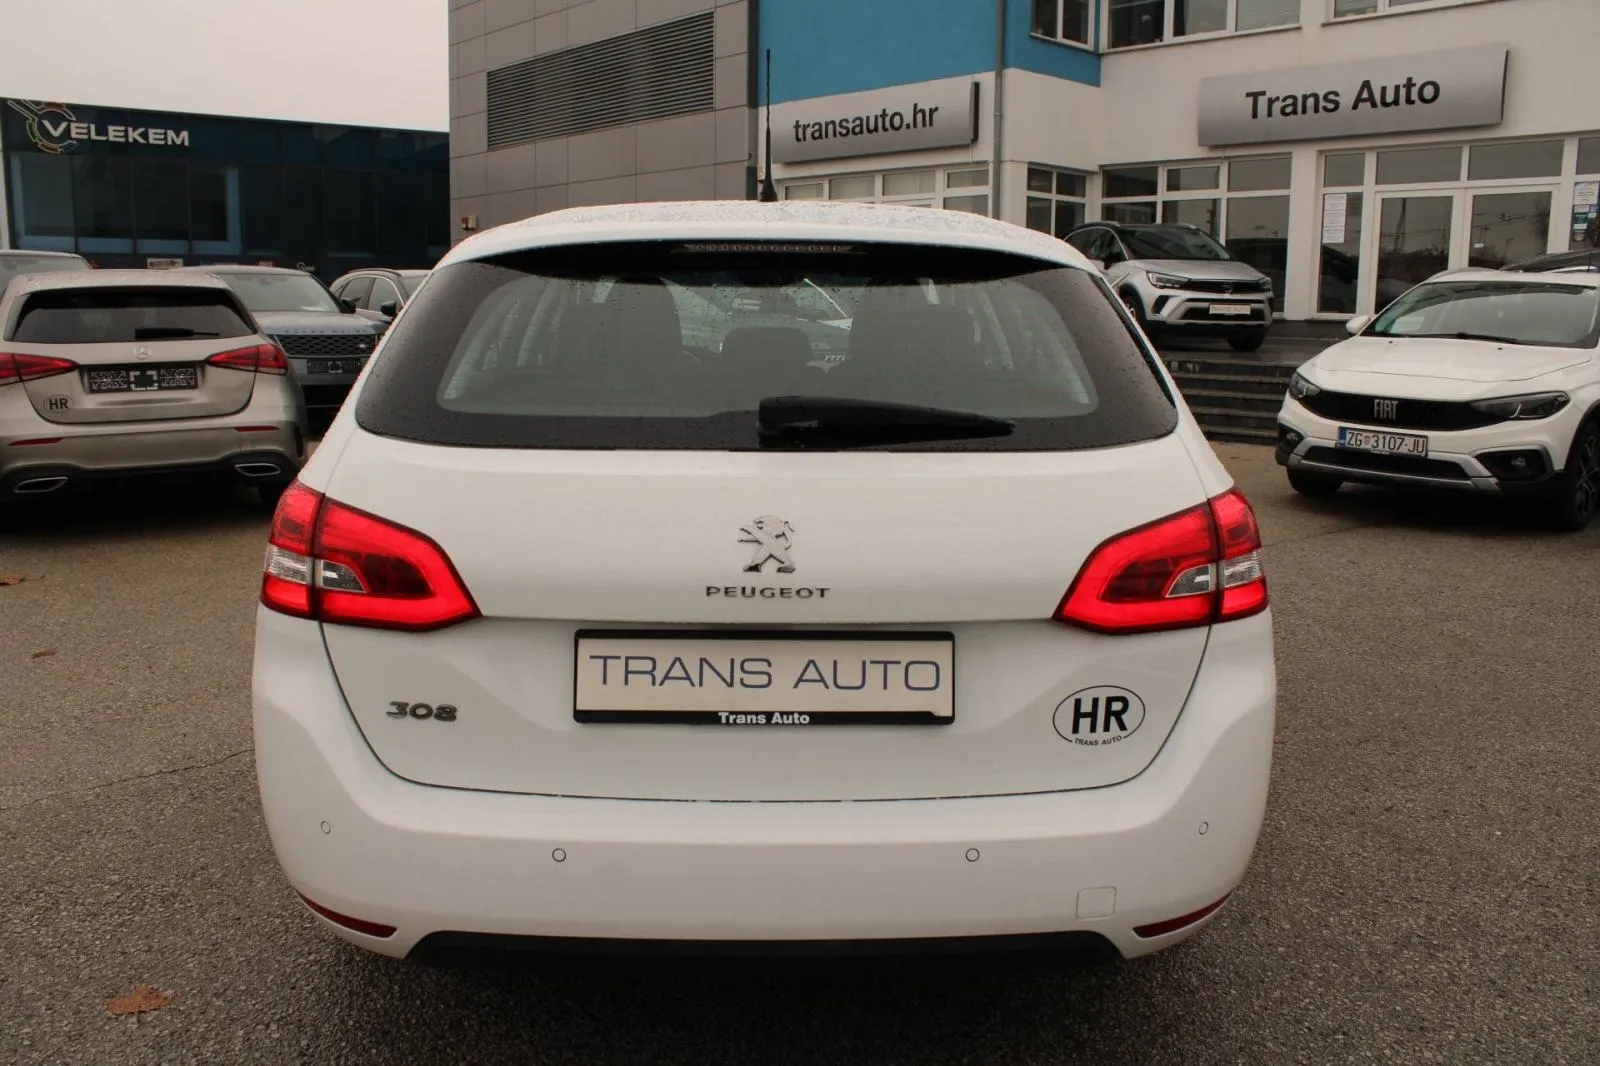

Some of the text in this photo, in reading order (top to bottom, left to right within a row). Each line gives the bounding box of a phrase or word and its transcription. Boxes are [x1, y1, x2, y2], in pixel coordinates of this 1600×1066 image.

[1245, 76, 1441, 120] Trans Auto
[41, 119, 190, 147] VELEKEM
[793, 103, 939, 143] transauto.hr
[48, 397, 69, 410] HR
[1373, 399, 1399, 420] FIAT
[1347, 431, 1363, 447] ZG
[706, 586, 831, 599] PEUGEOT
[589, 655, 941, 692] TRANS AUTO
[386, 701, 458, 722] 308
[718, 711, 810, 725] Trans Auto
[1071, 695, 1129, 735] HR
[1075, 735, 1122, 747] TRANS AUTO
